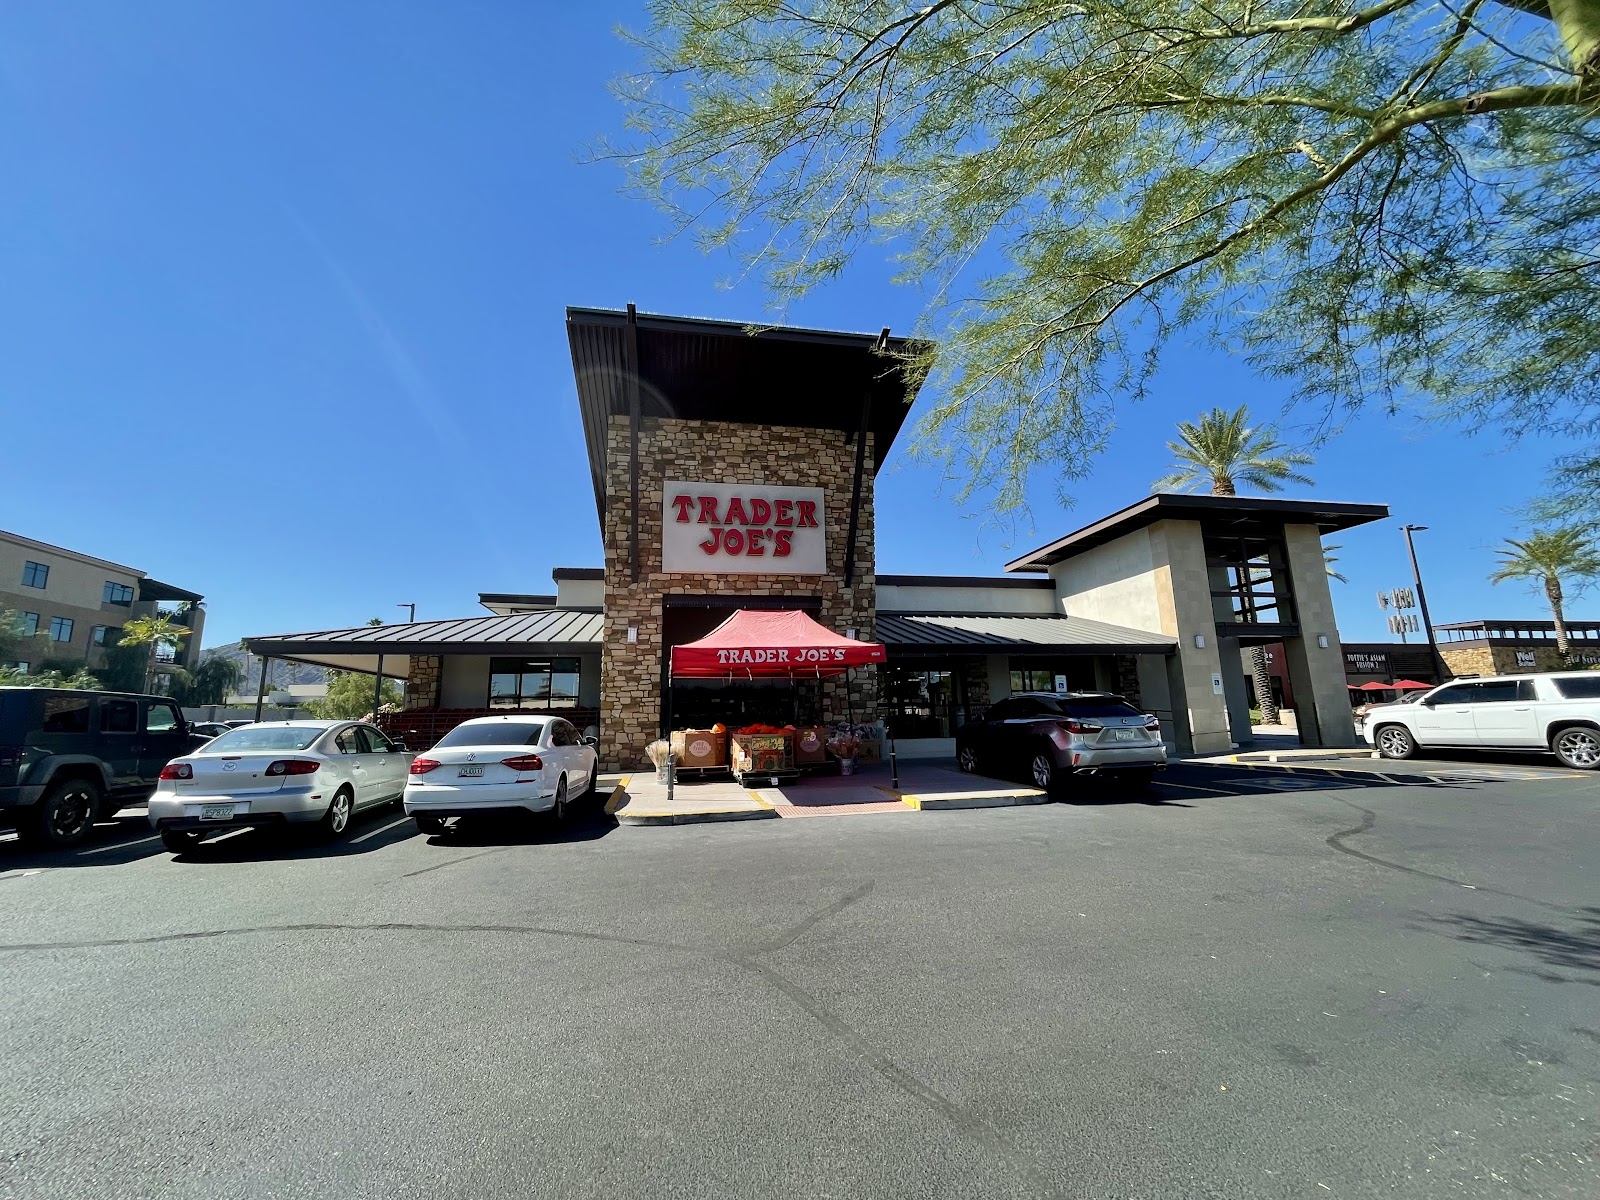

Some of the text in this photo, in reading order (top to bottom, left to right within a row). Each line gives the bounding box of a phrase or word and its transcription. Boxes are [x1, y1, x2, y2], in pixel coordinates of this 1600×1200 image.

[672, 495, 819, 527] TRADER
[699, 528, 794, 557] JOE'S
[717, 648, 847, 663] TRADER JOE'S
[1370, 654, 1386, 662] ASIAN
[1516, 651, 1535, 660] Well
